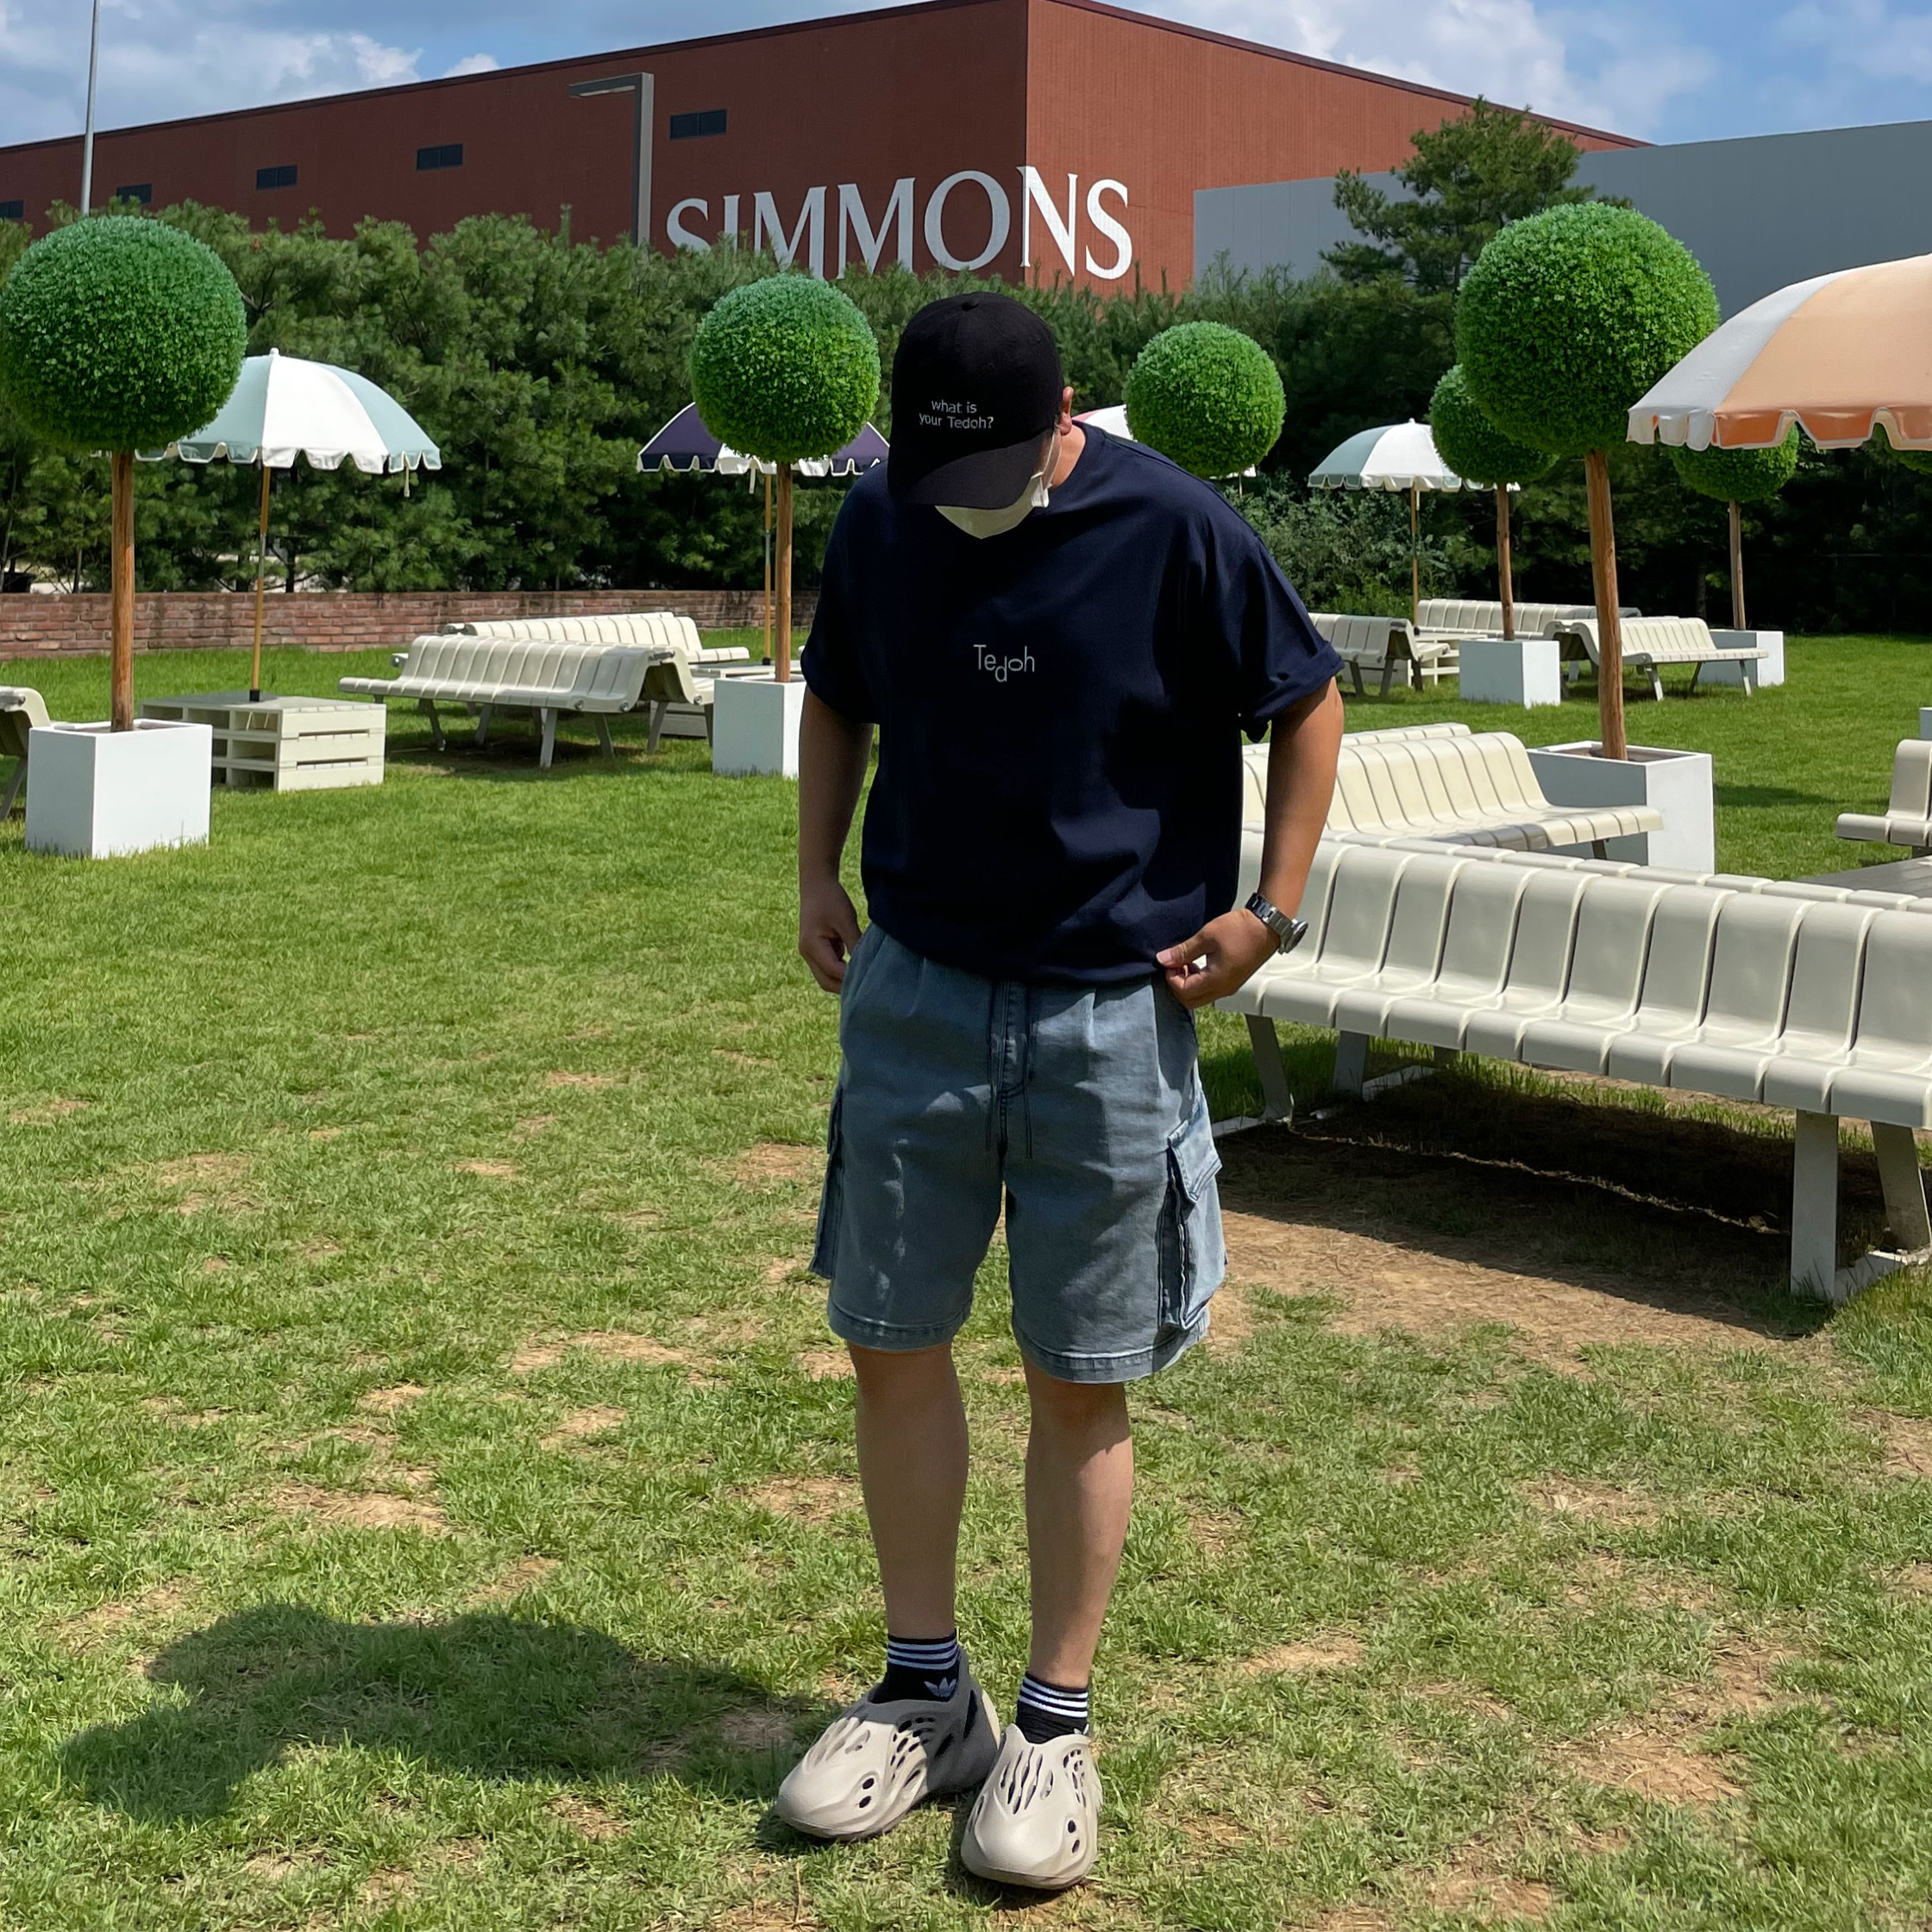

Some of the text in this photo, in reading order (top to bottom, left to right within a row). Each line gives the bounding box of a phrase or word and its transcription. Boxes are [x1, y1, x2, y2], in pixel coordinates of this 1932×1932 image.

[931, 399, 977, 414] what is
[919, 412, 994, 429] your Tedoh?
[973, 644, 1035, 682] Tedoh
